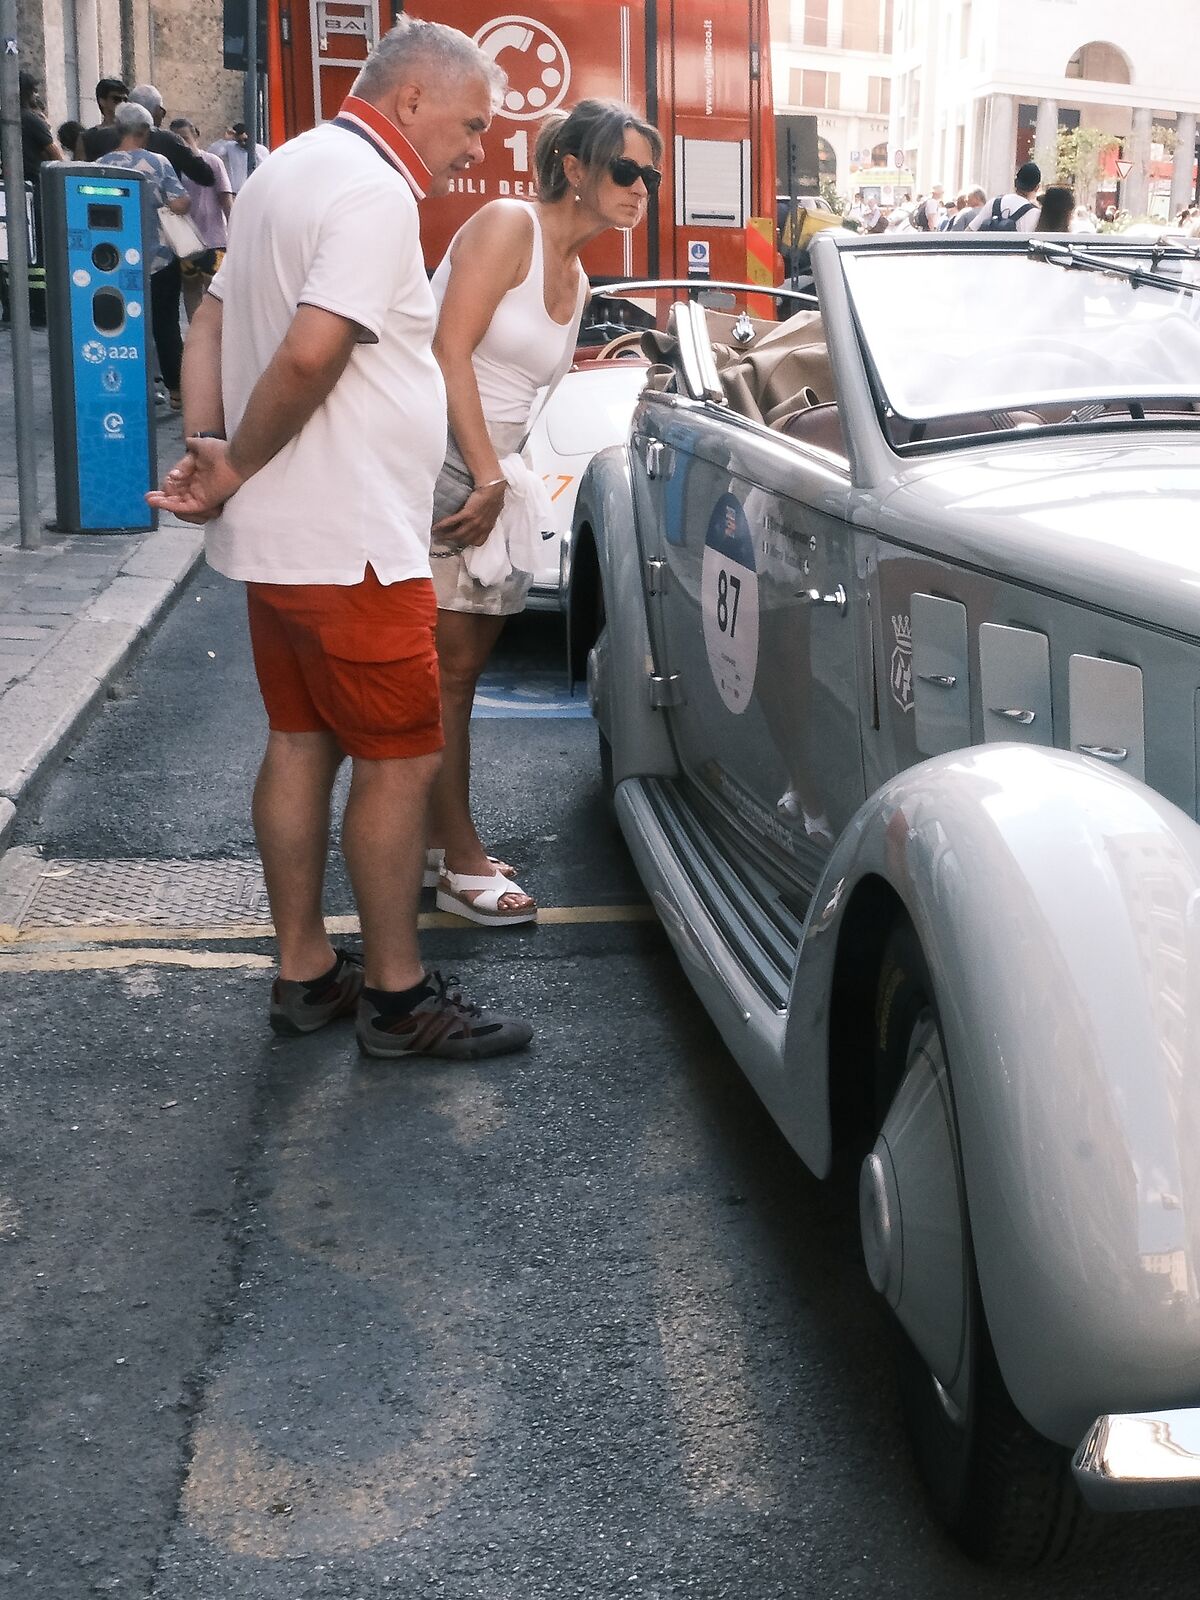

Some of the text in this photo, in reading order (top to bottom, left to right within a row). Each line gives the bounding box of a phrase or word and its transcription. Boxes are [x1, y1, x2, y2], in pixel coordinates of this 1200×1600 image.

[499, 180, 538, 197] DEL
[109, 346, 138, 360] a2a
[717, 569, 741, 638] 87
